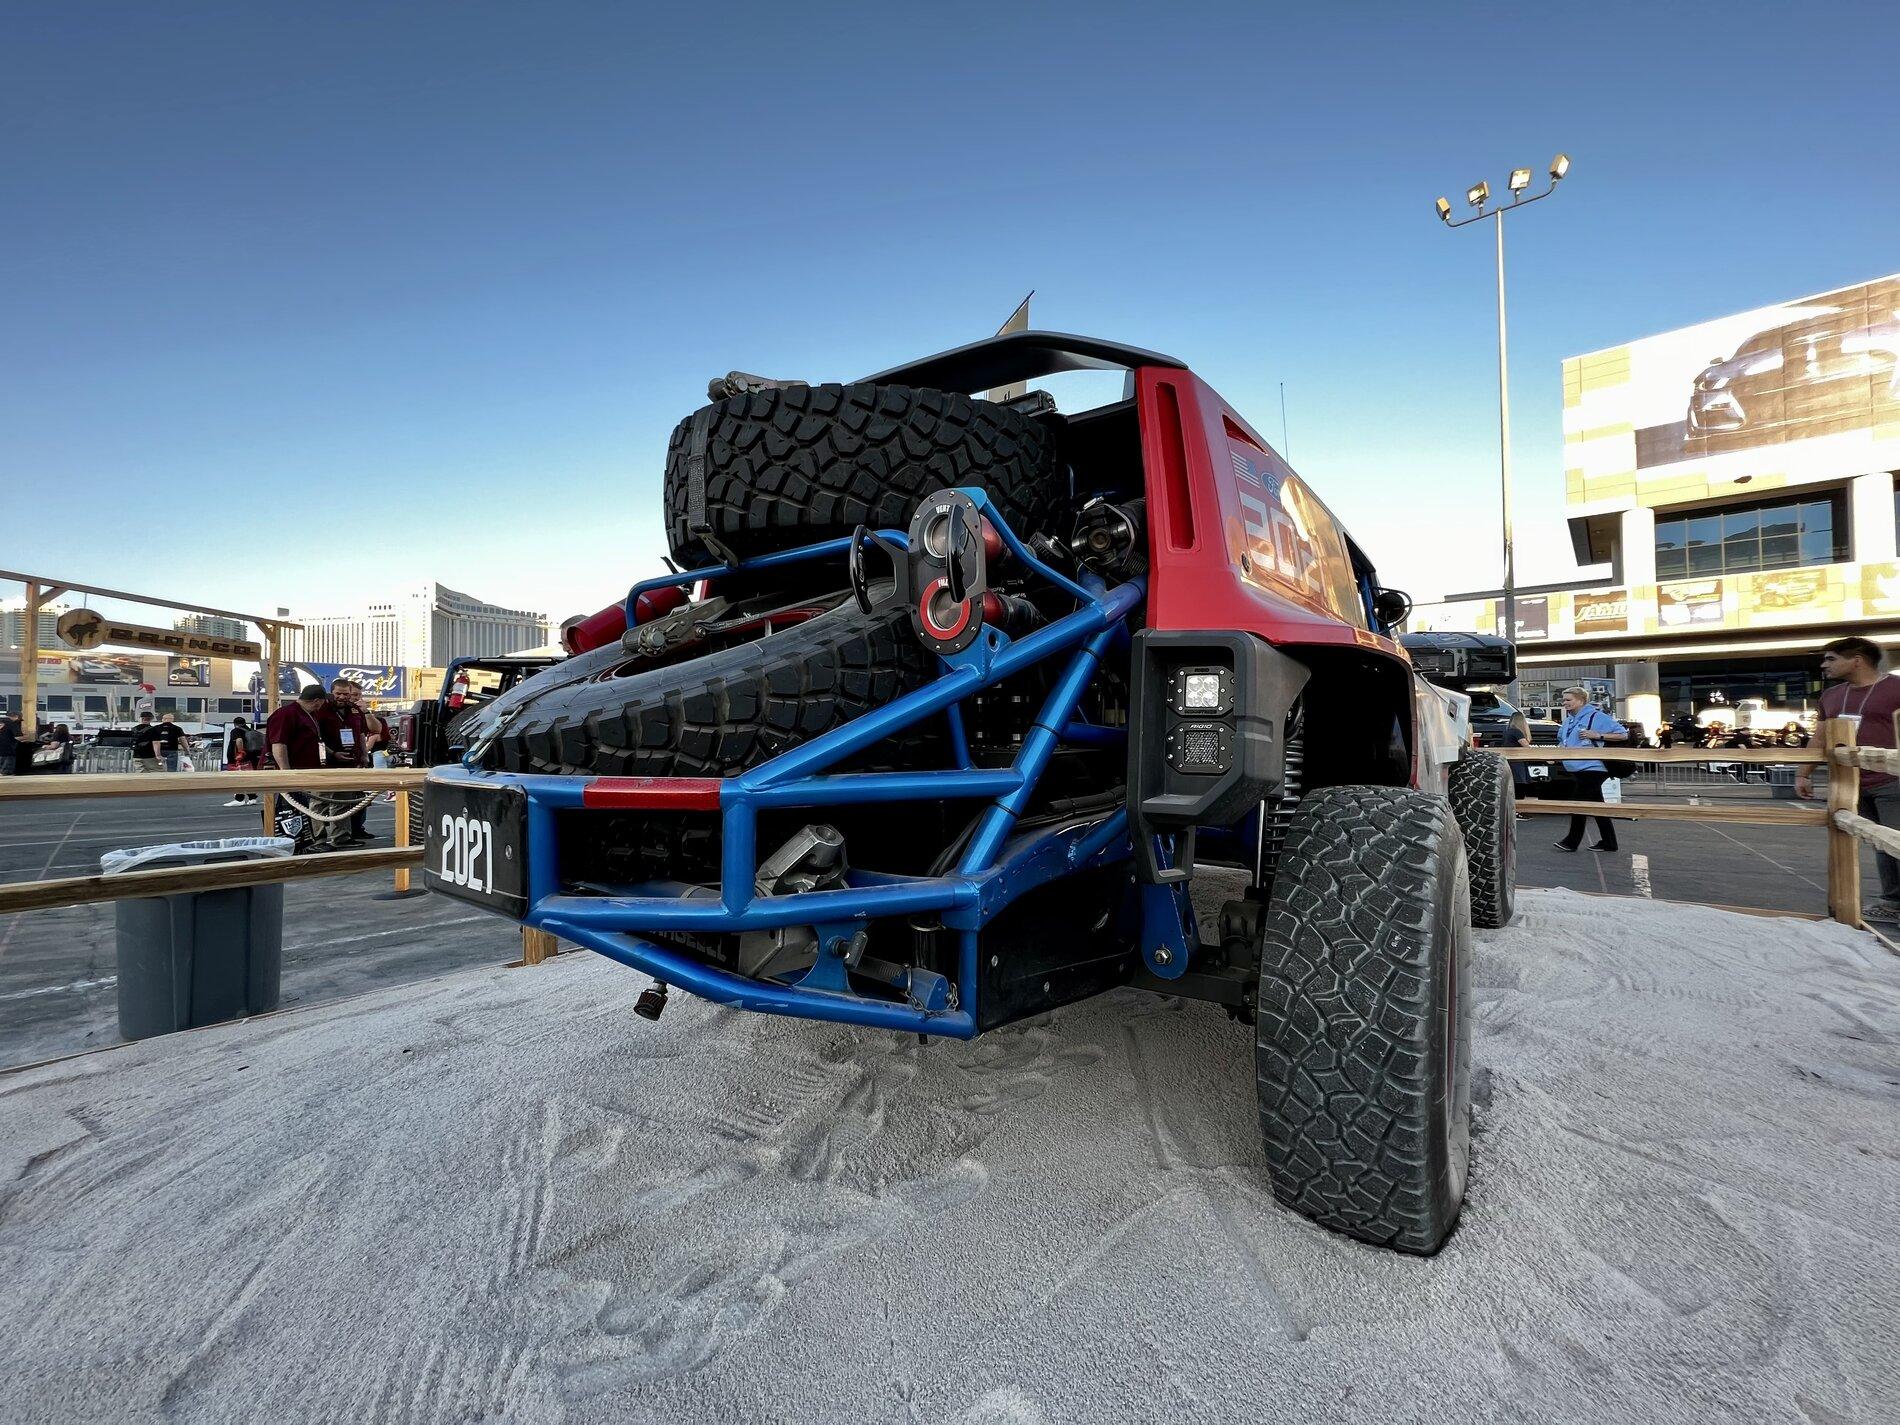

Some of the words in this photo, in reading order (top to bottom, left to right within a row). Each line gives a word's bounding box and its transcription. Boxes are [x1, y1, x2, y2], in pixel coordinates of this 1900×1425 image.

[935, 504, 951, 514] VENT
[110, 628, 253, 655] BRONCO
[332, 668, 397, 692] Ford
[440, 814, 493, 895] 2021
